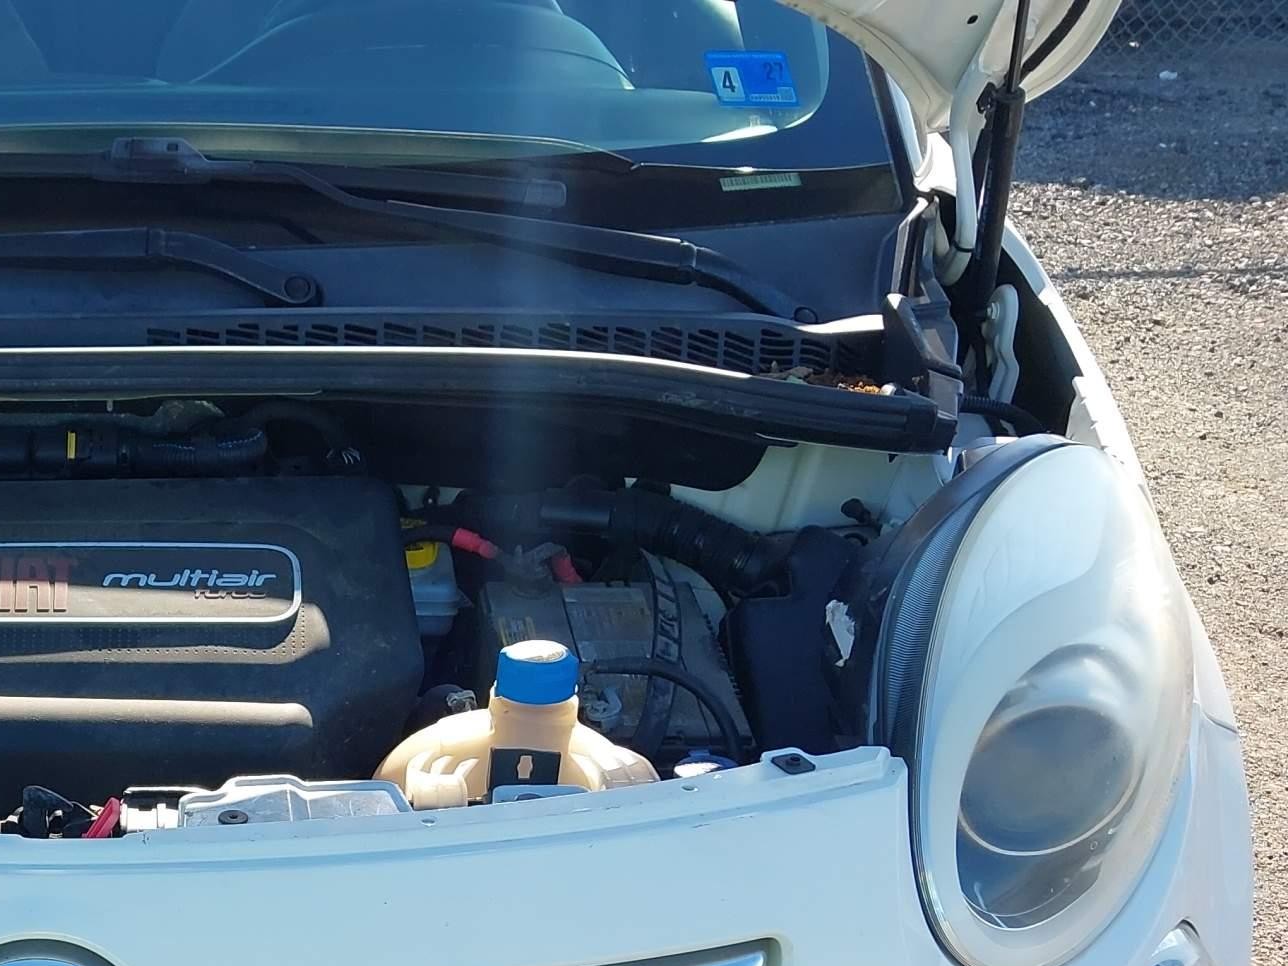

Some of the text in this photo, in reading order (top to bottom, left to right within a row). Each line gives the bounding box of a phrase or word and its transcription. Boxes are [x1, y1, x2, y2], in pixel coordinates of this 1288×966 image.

[722, 70, 736, 93] 4
[762, 62, 784, 81] 27
[102, 568, 277, 588] multiair
